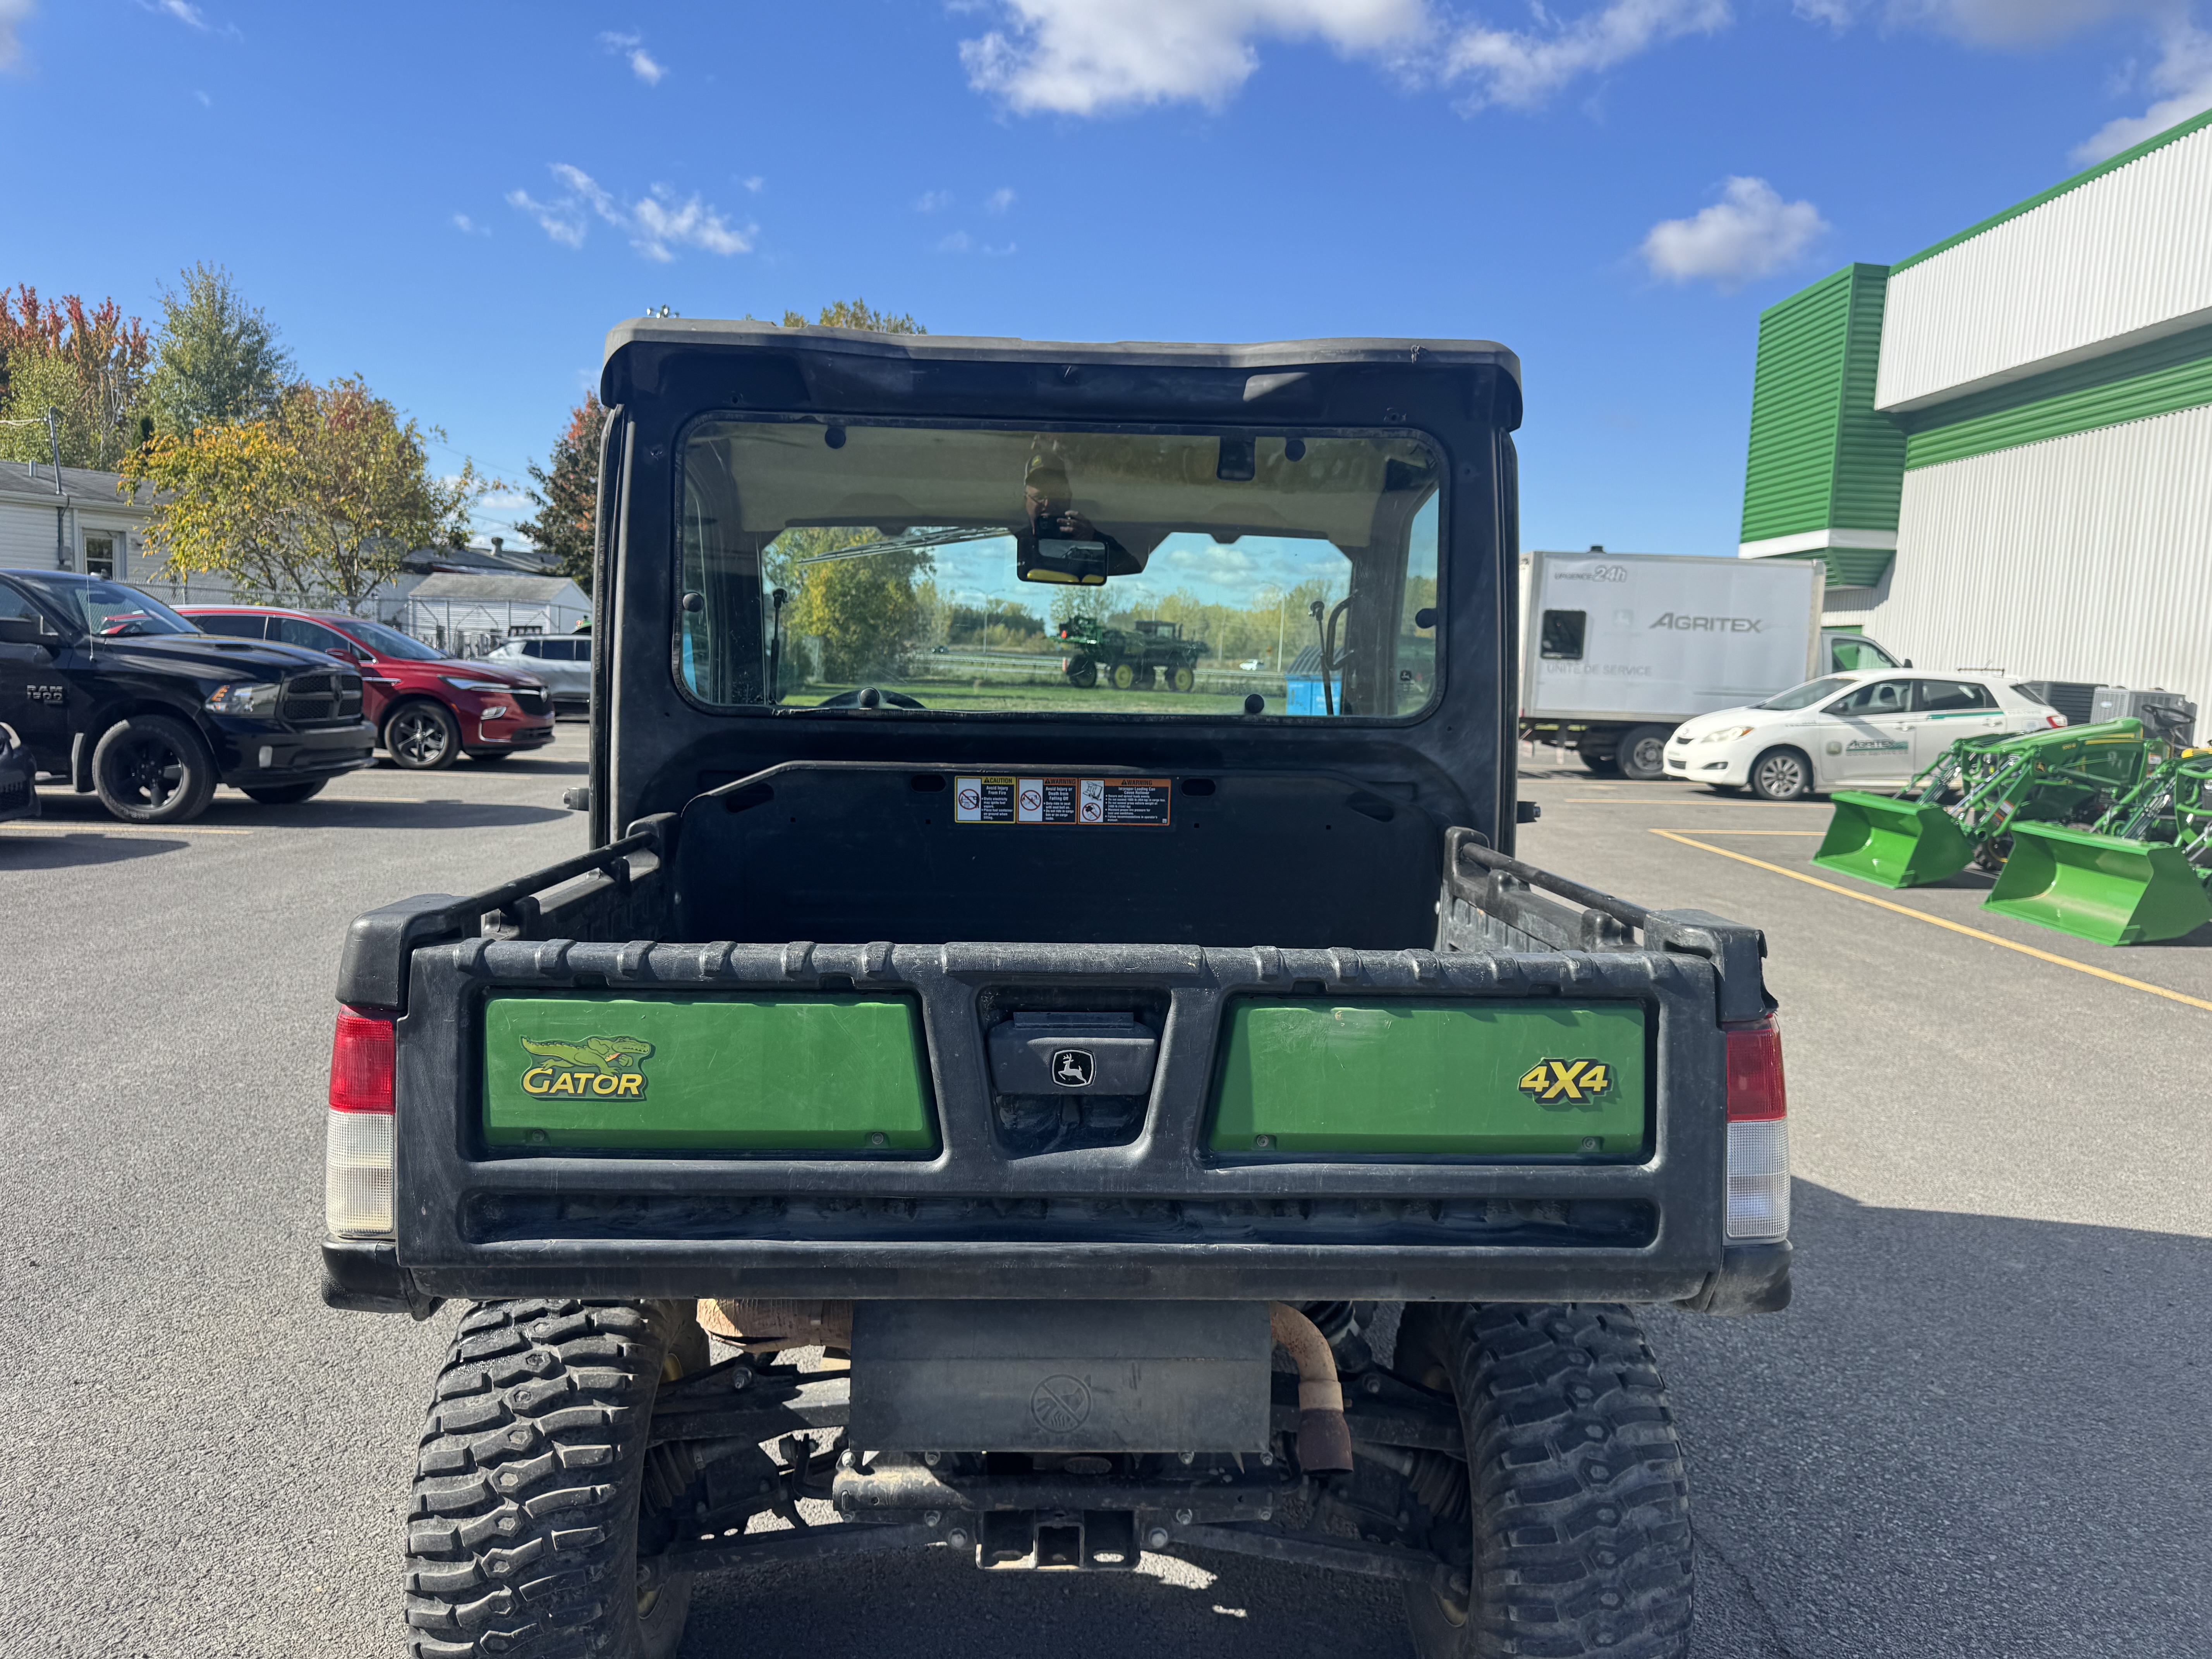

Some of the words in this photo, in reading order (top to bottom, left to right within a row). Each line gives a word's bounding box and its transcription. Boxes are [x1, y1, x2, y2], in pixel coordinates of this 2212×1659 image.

[1592, 565, 1627, 583] 24h
[1648, 612, 1762, 634] AGRITEX
[1583, 664, 1599, 674] DE
[1602, 664, 1653, 676] SERVICE
[523, 1067, 642, 1095] GATOR
[1520, 1061, 1608, 1098] 4X4
